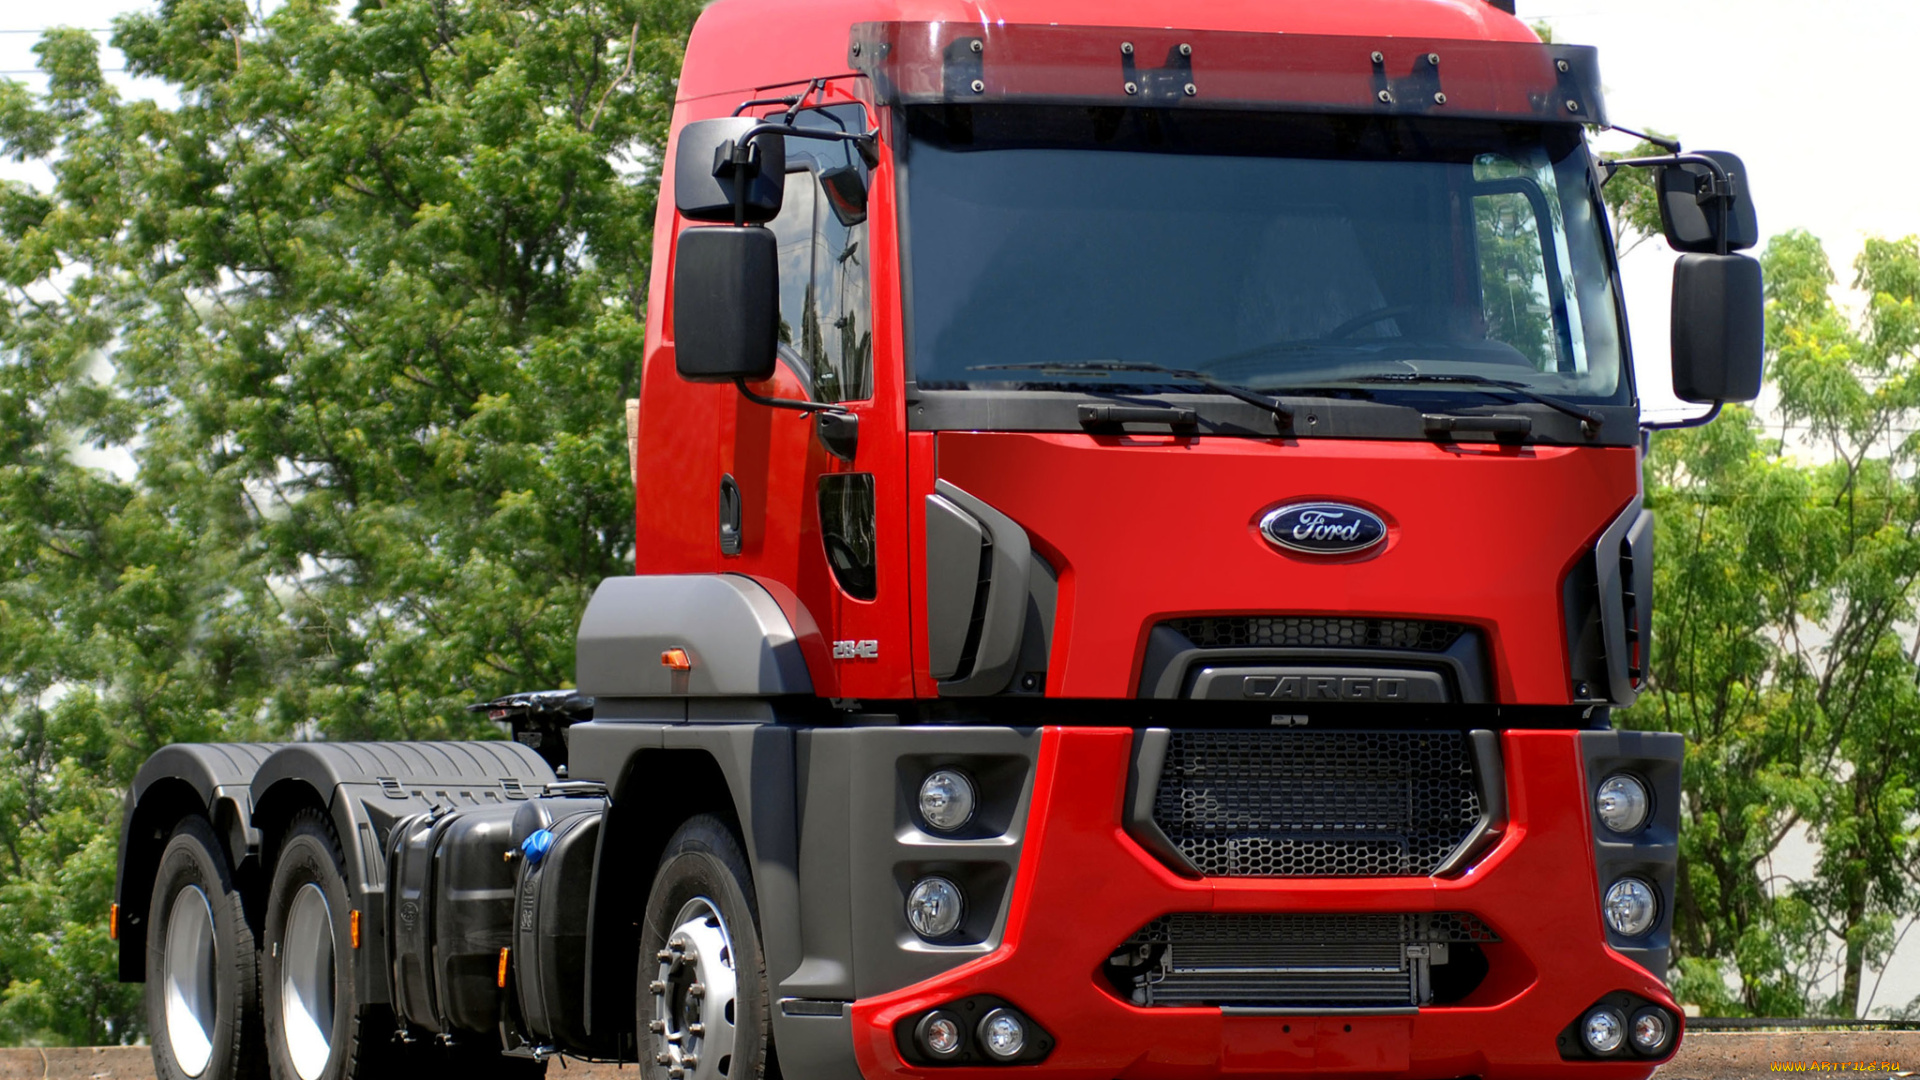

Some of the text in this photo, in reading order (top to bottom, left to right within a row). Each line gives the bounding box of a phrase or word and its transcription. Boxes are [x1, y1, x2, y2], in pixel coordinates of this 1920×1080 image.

[1292, 510, 1361, 541] Ford
[833, 640, 878, 659] 2842
[1243, 676, 1407, 700] CARGO
